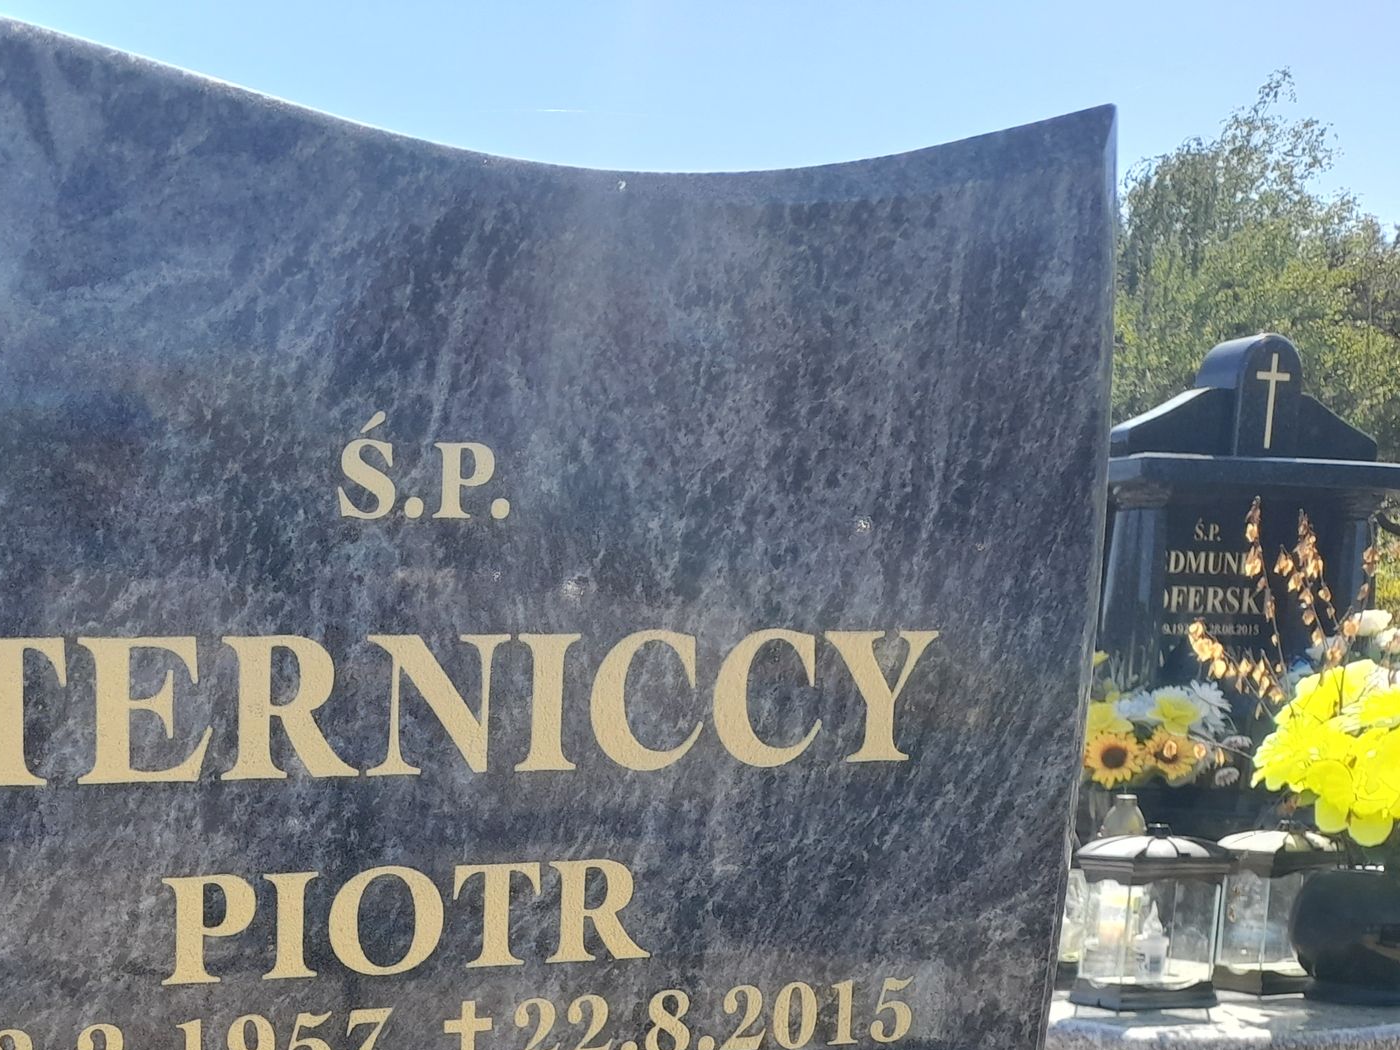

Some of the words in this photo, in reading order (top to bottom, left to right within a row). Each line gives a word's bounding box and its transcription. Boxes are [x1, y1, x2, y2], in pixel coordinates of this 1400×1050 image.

[337, 411, 511, 521] Ś.P.
[1165, 550, 1248, 575] DMUN
[1193, 518, 1221, 542] Ś.P.
[160, 858, 652, 986] PIOTR
